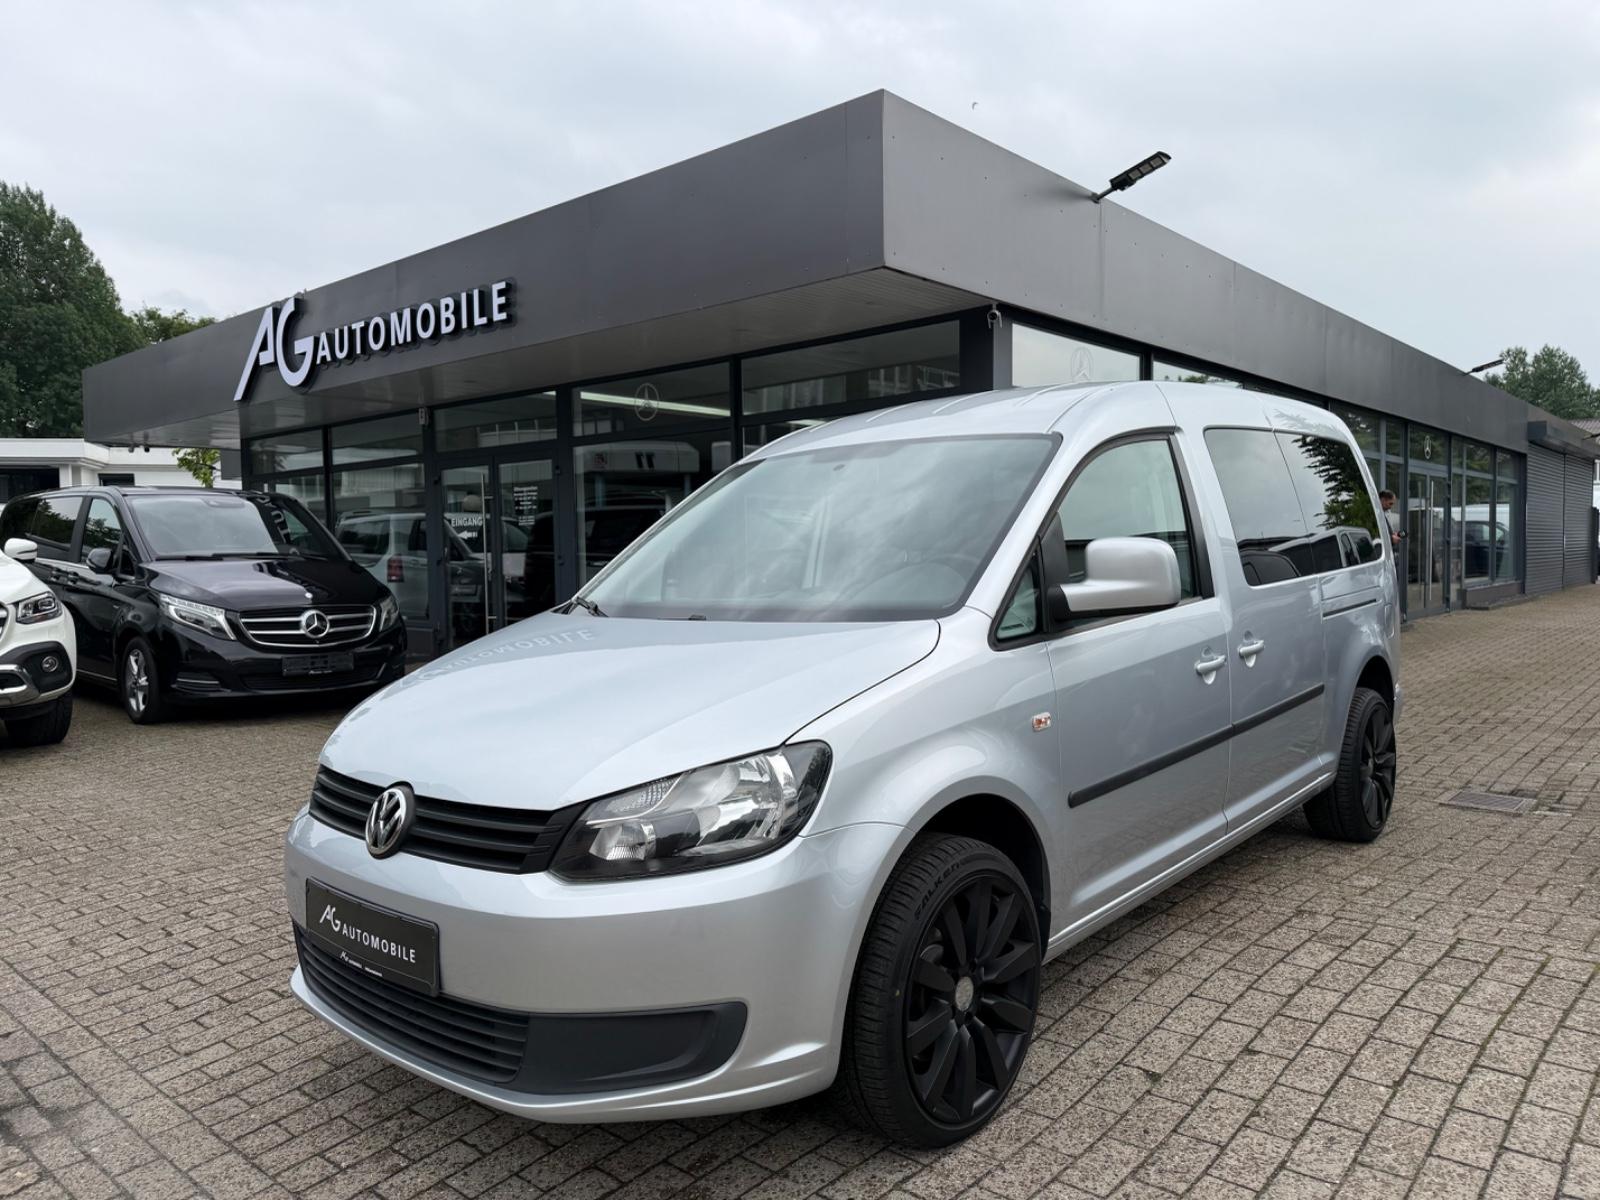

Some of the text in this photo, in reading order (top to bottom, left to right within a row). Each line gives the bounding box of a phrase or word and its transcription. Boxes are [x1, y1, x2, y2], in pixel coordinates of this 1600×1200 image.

[234, 281, 507, 401] AG AUTOMOBILE
[451, 516, 482, 527] EINGANG
[319, 904, 416, 963] AG AUTOMOBILE
